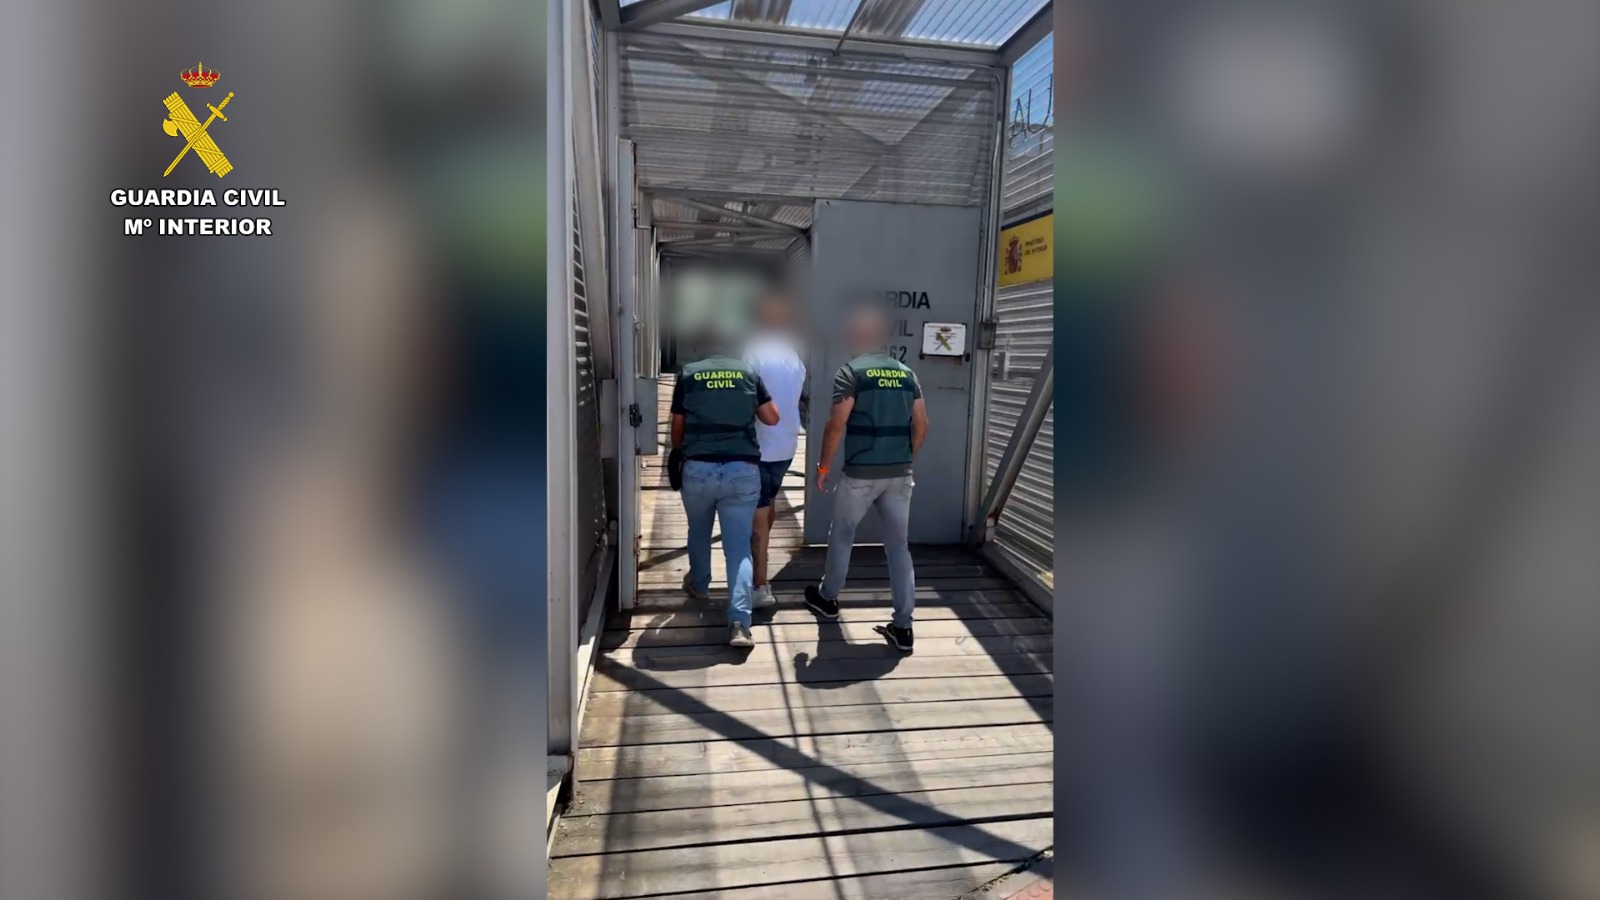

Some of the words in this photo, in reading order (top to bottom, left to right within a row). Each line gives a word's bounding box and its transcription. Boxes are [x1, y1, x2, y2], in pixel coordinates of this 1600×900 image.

[693, 371, 744, 381] GUARDIA
[866, 369, 907, 378] GUARDIA
[706, 379, 736, 389] CIVIL
[878, 378, 903, 388] CIVIL
